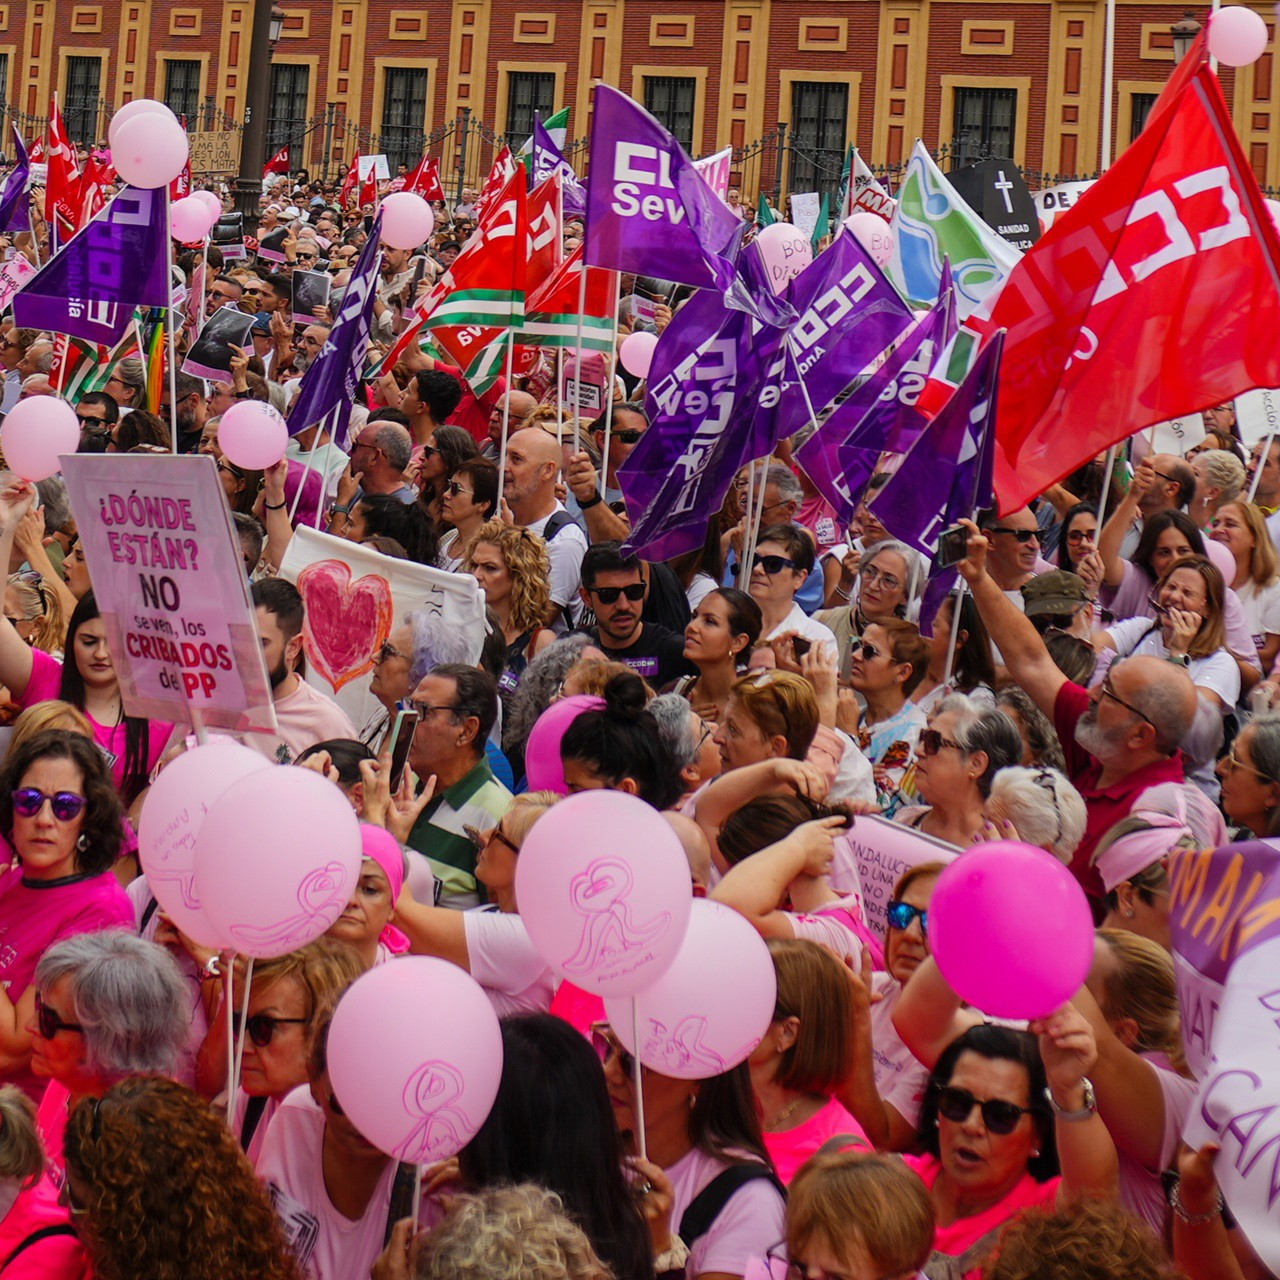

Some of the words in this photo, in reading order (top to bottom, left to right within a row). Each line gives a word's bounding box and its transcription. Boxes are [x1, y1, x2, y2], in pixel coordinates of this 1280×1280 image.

[210, 159, 237, 171] MATA
[997, 223, 1030, 235] SANIDAD
[99, 489, 197, 532] ¿DÓNDE
[107, 531, 200, 571] ESTÁN?
[138, 574, 181, 612] NO
[133, 614, 150, 631] se
[181, 618, 207, 638] los
[125, 632, 234, 673] CRIBADOS
[180, 671, 218, 701] PP
[863, 883, 884, 899] NO
